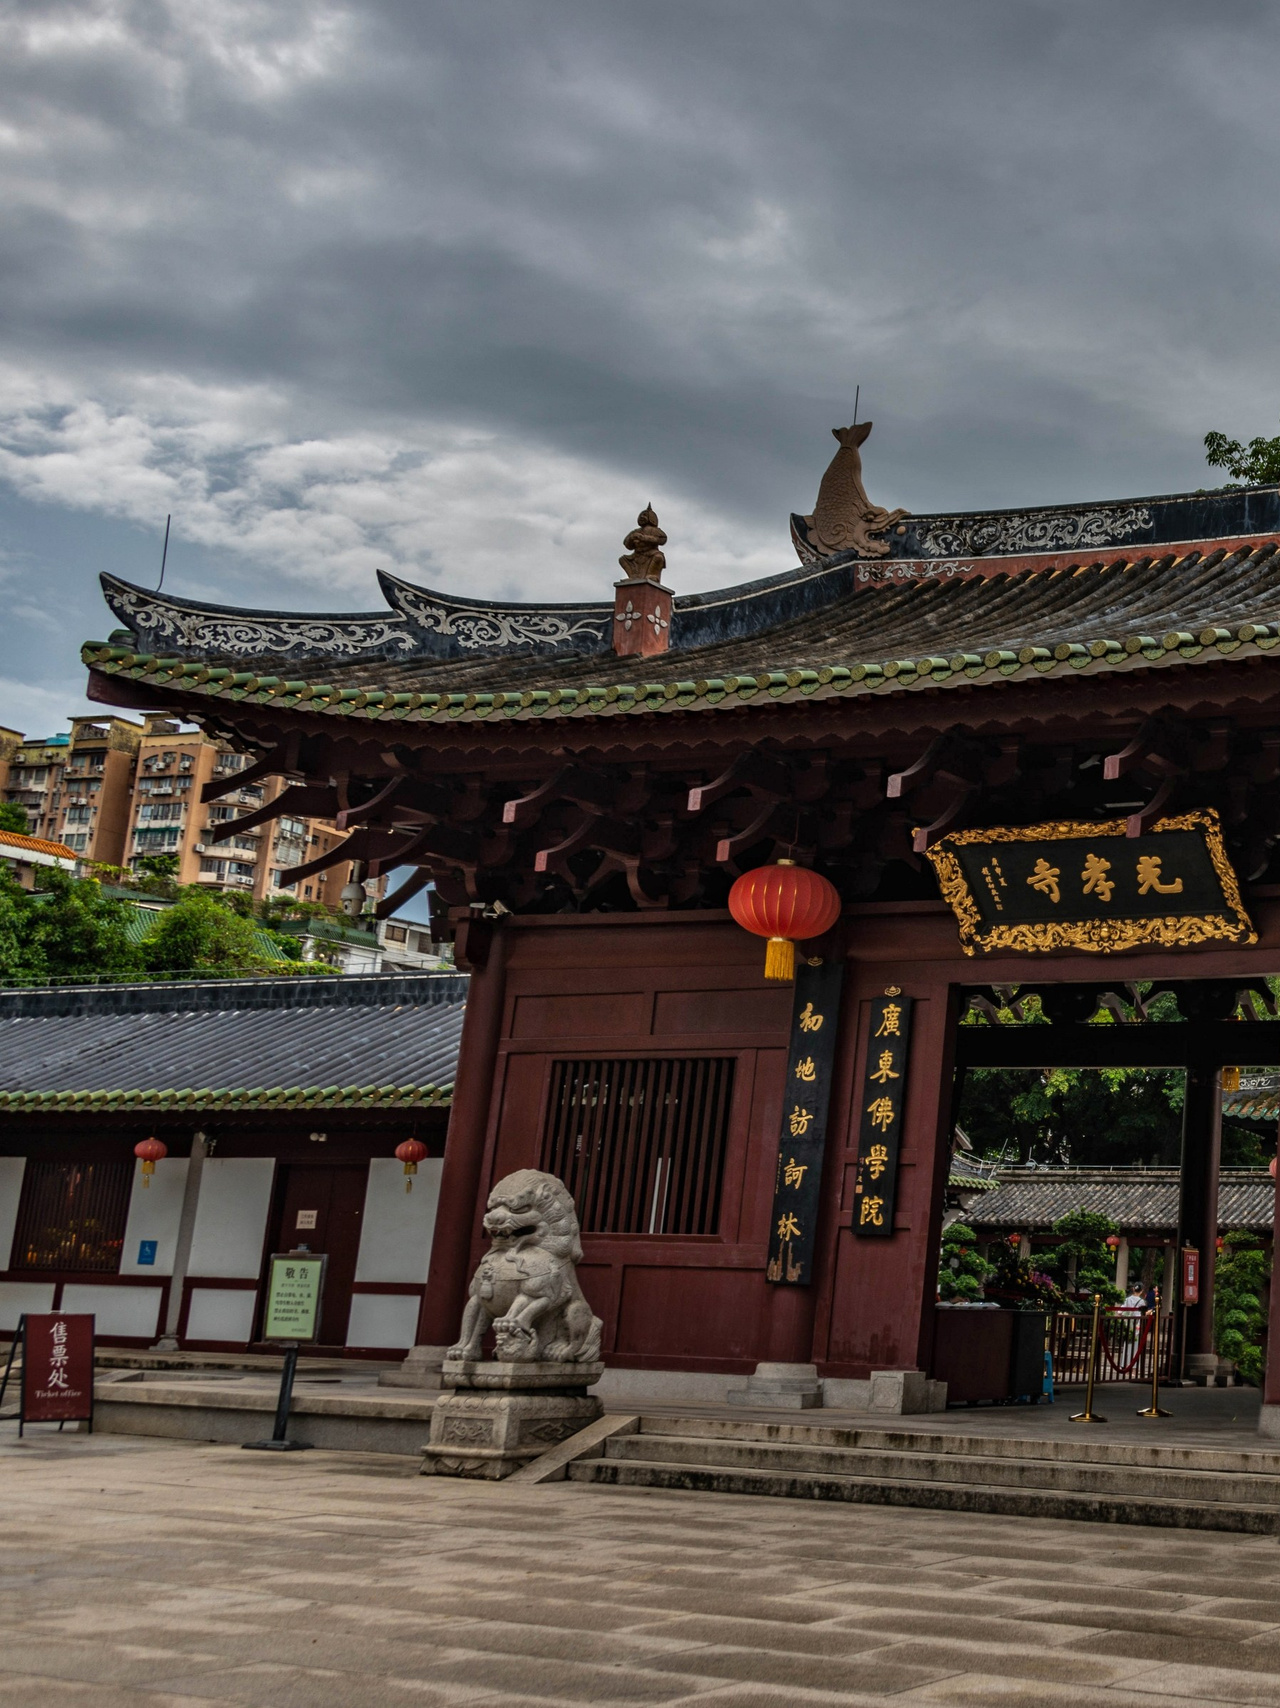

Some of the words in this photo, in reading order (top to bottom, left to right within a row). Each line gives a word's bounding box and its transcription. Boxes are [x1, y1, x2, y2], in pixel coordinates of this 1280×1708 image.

[777, 1002, 824, 1241] 初地訪訶林
[860, 1003, 902, 1226] 廣東佛學院
[285, 1267, 309, 1280] 敬告
[48, 1321, 70, 1389] 售票处
